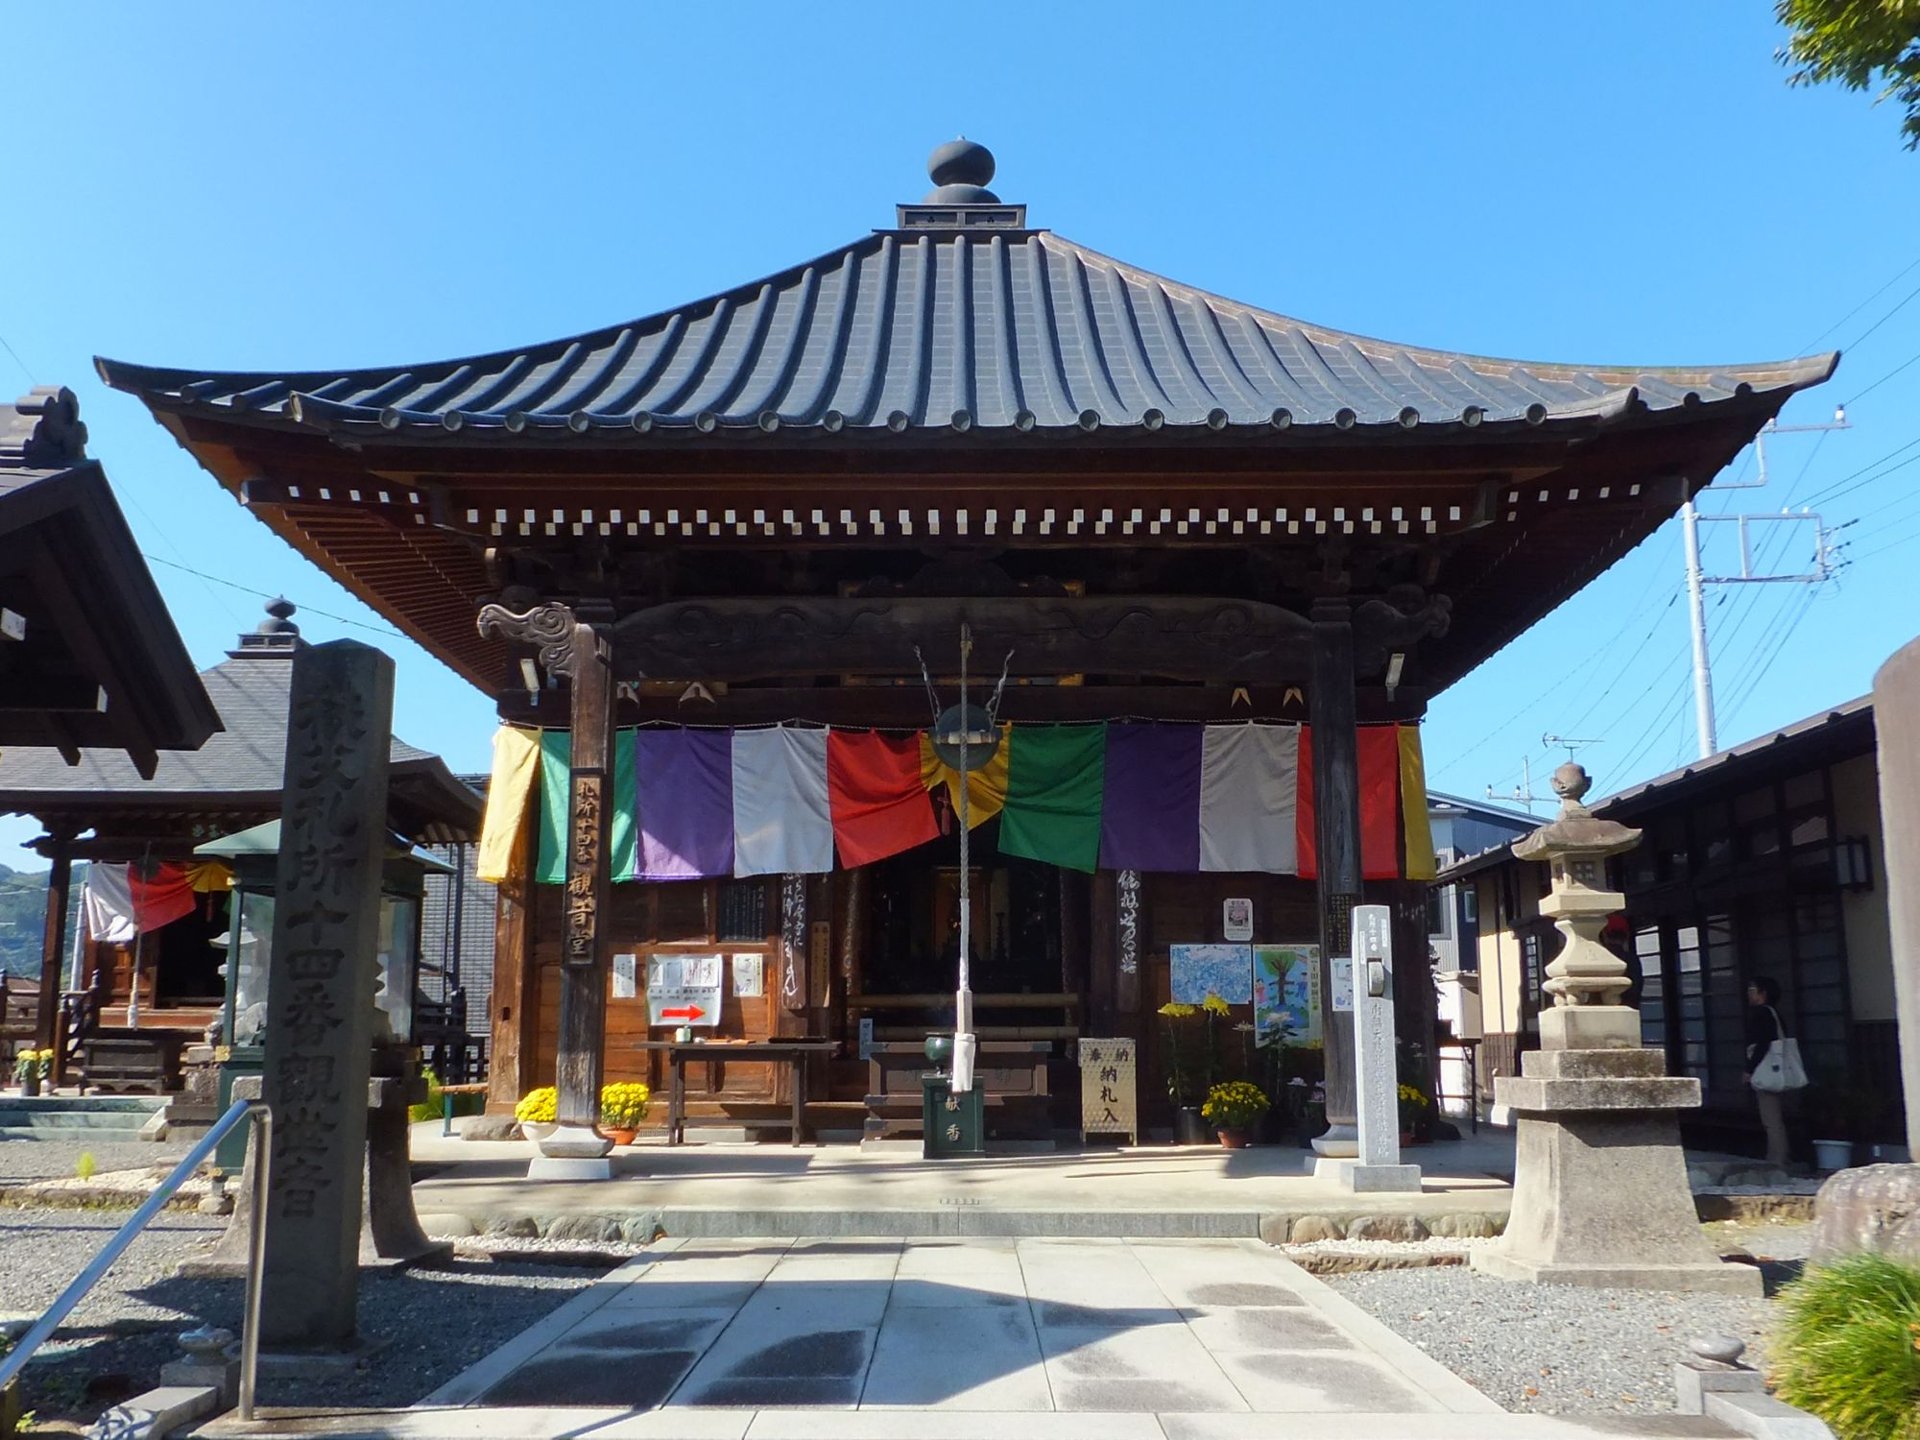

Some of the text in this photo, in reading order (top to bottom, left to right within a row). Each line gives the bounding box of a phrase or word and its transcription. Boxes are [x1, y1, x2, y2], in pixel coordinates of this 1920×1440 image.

[567, 871, 595, 954] 観音堂
[945, 1095, 961, 1142] 献香
[1100, 1066, 1119, 1123] 納札入
